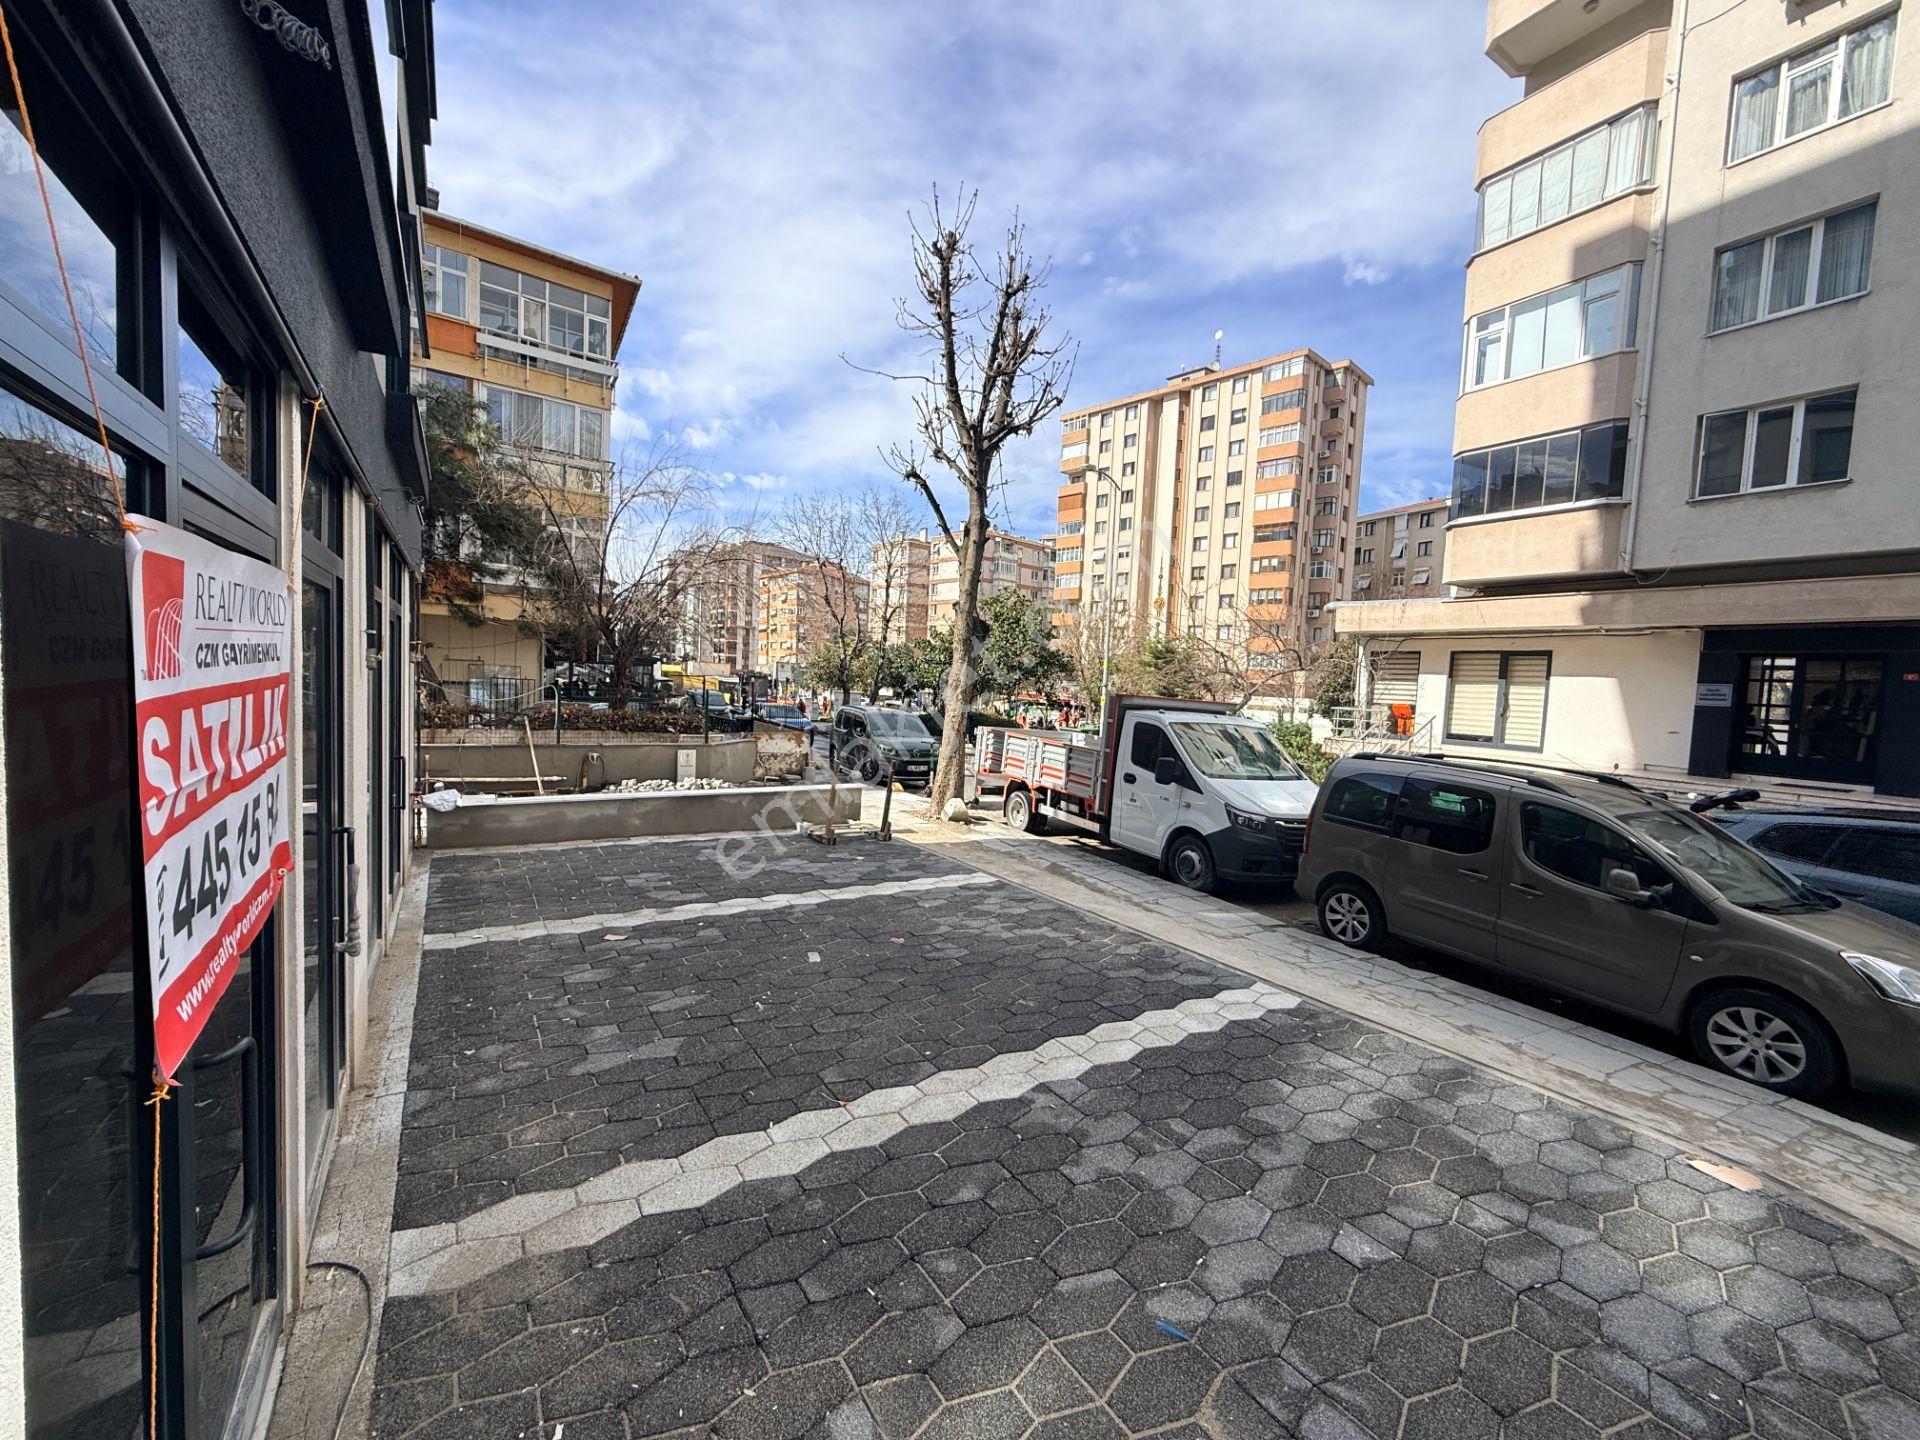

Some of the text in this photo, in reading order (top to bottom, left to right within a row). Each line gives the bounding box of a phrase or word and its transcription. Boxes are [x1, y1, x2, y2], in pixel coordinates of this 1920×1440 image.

[195, 573, 287, 626] REALTY WORLD
[196, 643, 219, 669] CZM
[143, 684, 285, 836] SATILIK
[173, 818, 230, 940] 445
[237, 793, 260, 878] 15
